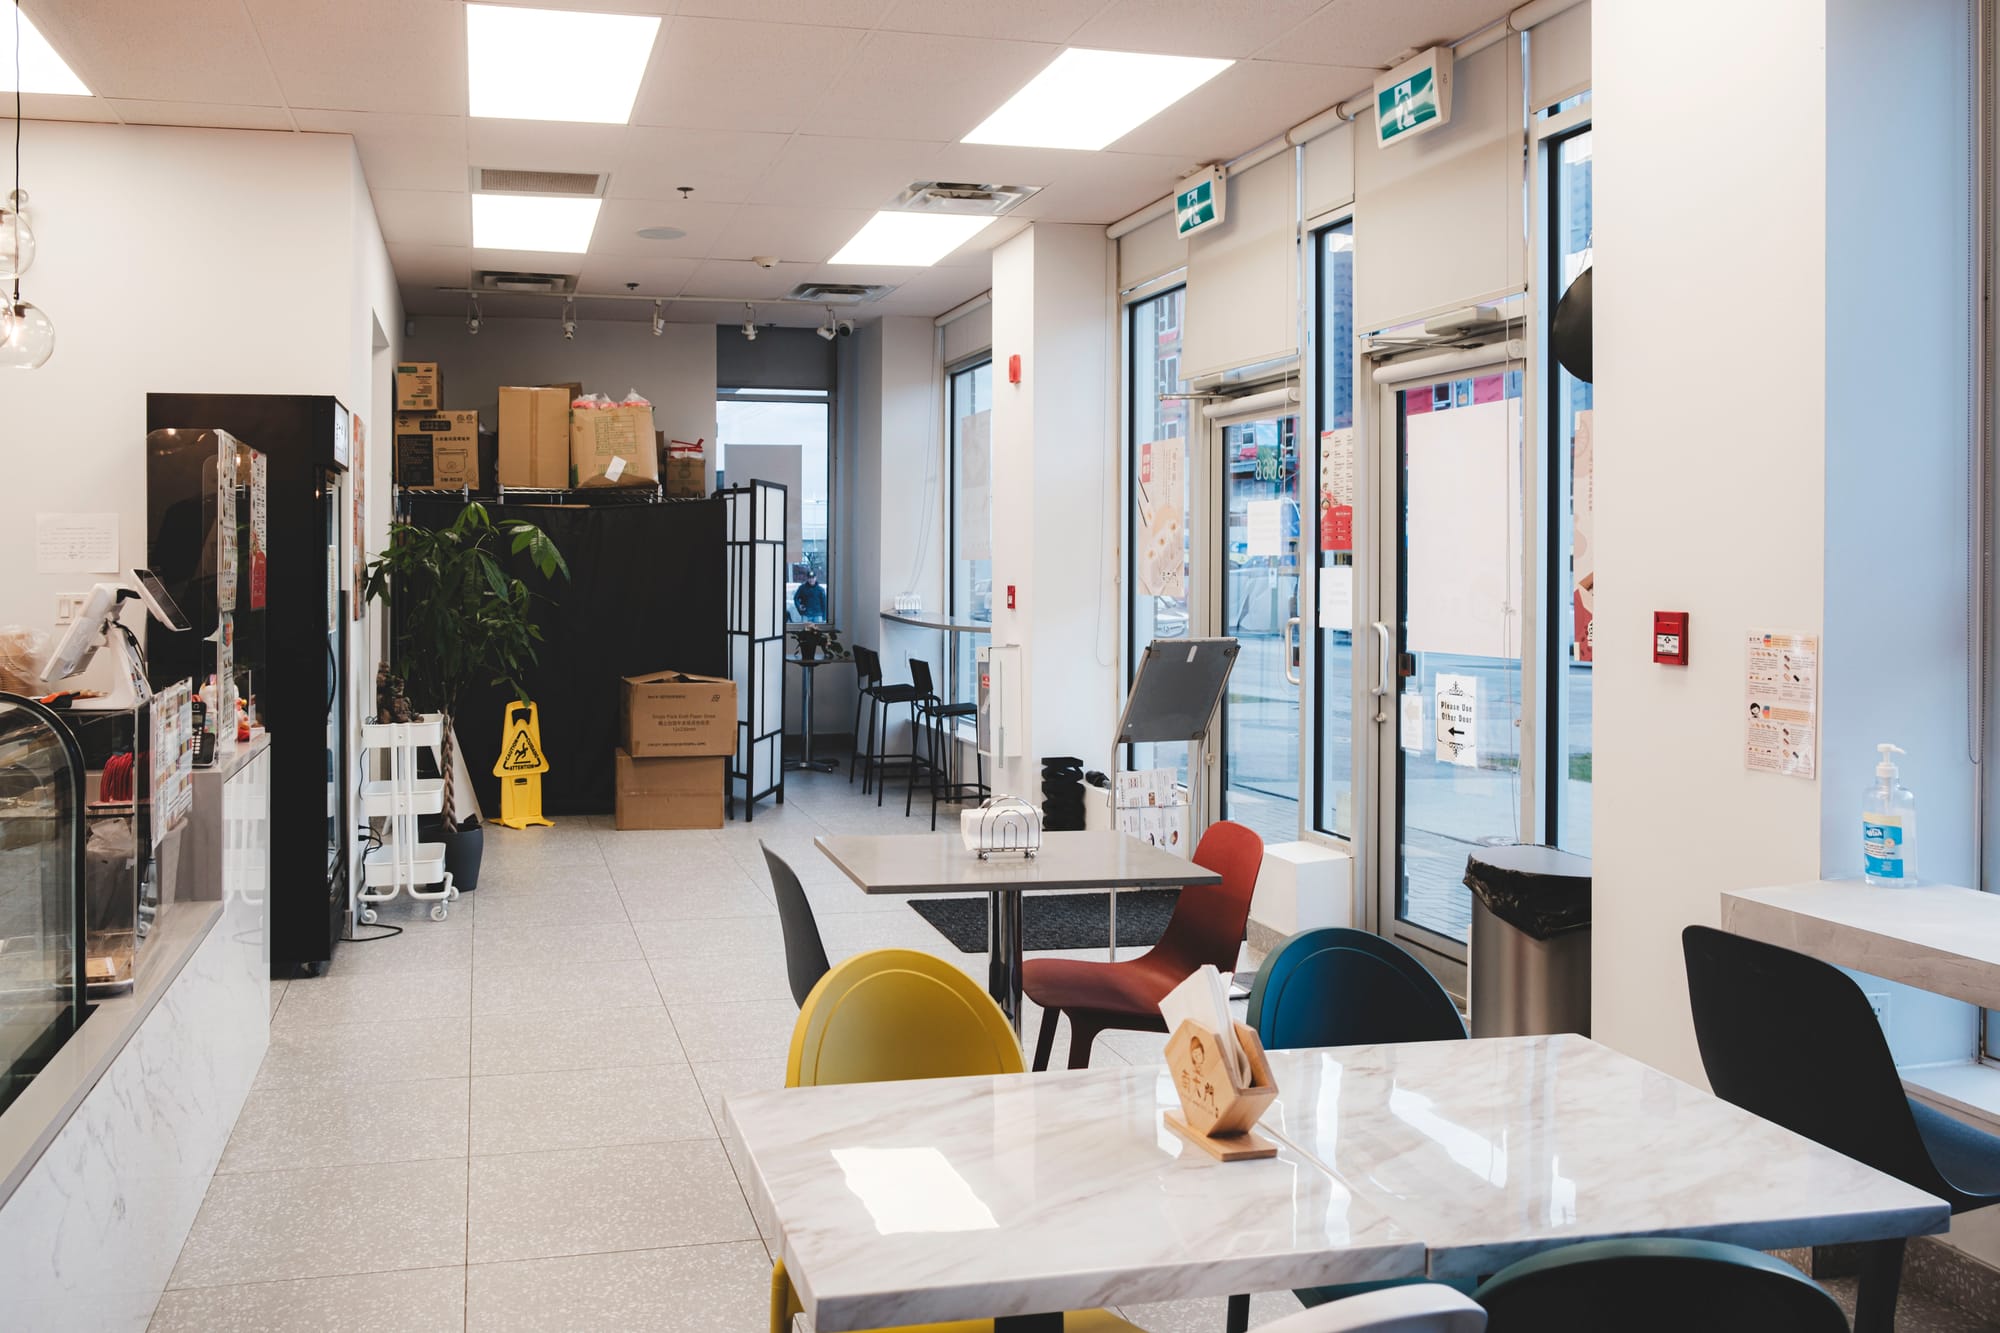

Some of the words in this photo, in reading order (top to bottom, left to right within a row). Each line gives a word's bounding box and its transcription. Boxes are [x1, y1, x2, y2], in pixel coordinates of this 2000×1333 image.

[1440, 701, 1460, 711] Please
[1461, 704, 1472, 713] Use
[1441, 712, 1457, 721] Other
[1458, 714, 1472, 724] Door
[505, 738, 518, 761] CAUTION
